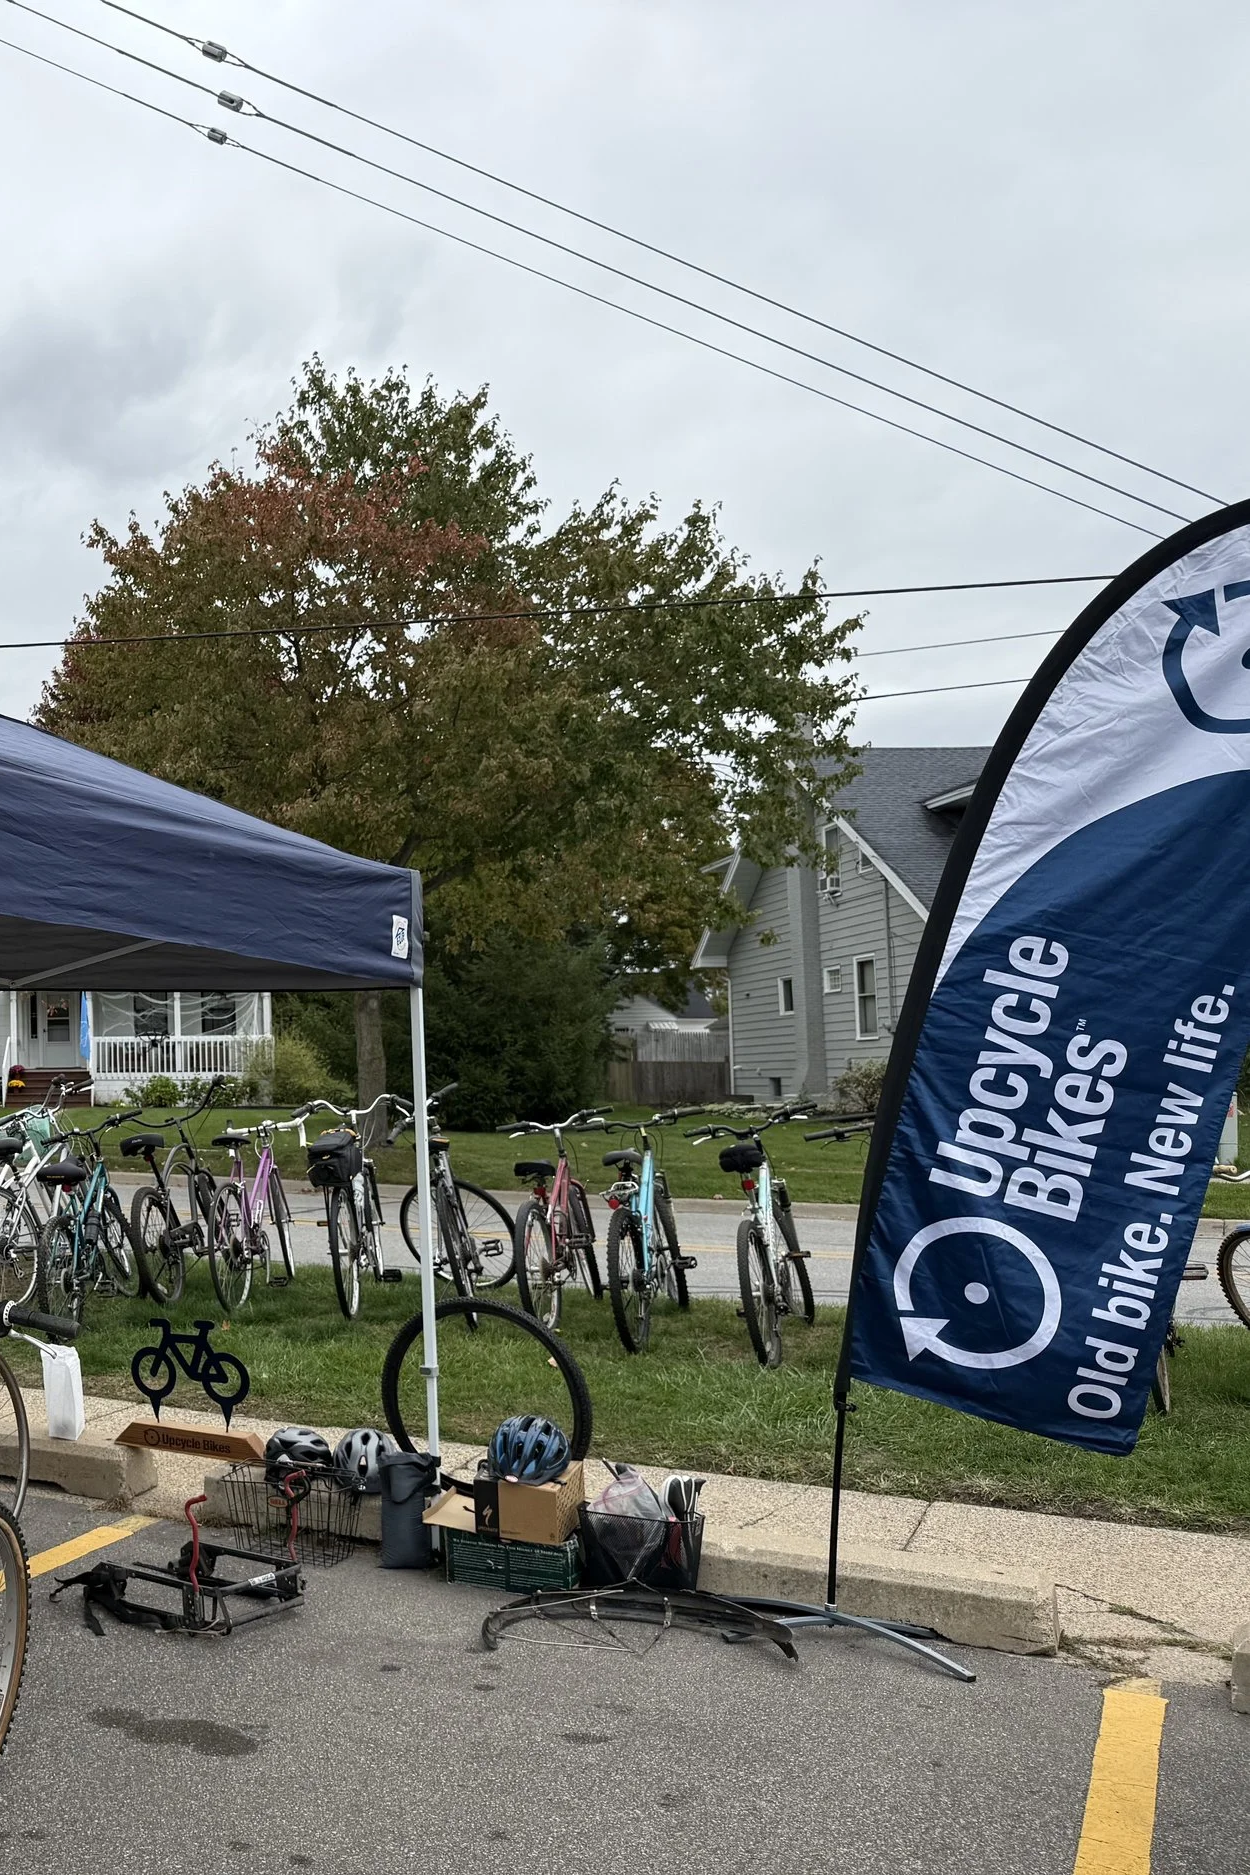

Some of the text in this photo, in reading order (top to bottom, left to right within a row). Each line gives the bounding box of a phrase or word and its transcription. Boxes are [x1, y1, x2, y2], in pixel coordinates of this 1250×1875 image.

[928, 936, 1069, 1197] Upcycle
[1004, 1034, 1127, 1221] Bikes
[1068, 985, 1234, 1418] Old bike. New life.
[162, 1433, 230, 1454] Upcycle Bikes
